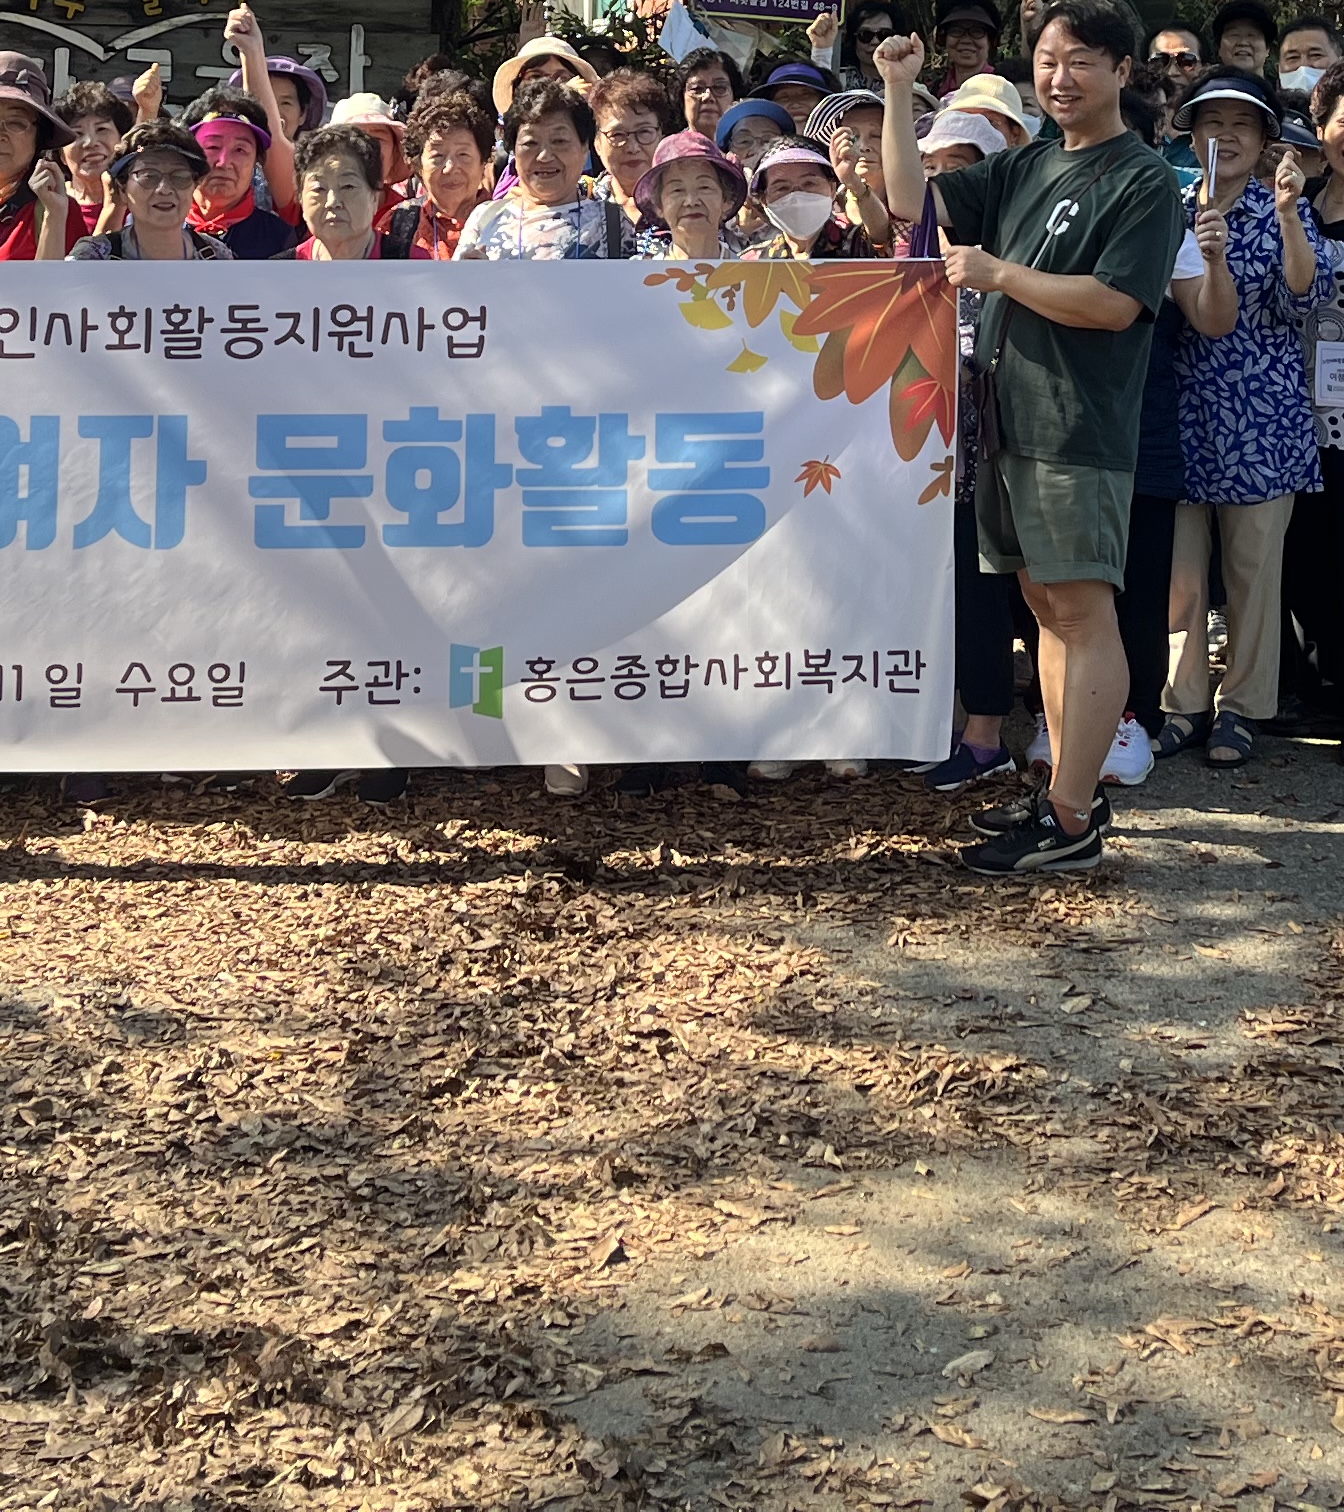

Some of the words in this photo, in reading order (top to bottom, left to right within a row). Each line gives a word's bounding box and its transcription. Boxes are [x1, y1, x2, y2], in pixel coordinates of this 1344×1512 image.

[248, 404, 771, 550] 문화활동
[44, 661, 83, 708] 일
[115, 661, 246, 707] 수요일
[318, 659, 422, 706] 주관:
[520, 648, 927, 703] 홍은종합사회복지관
